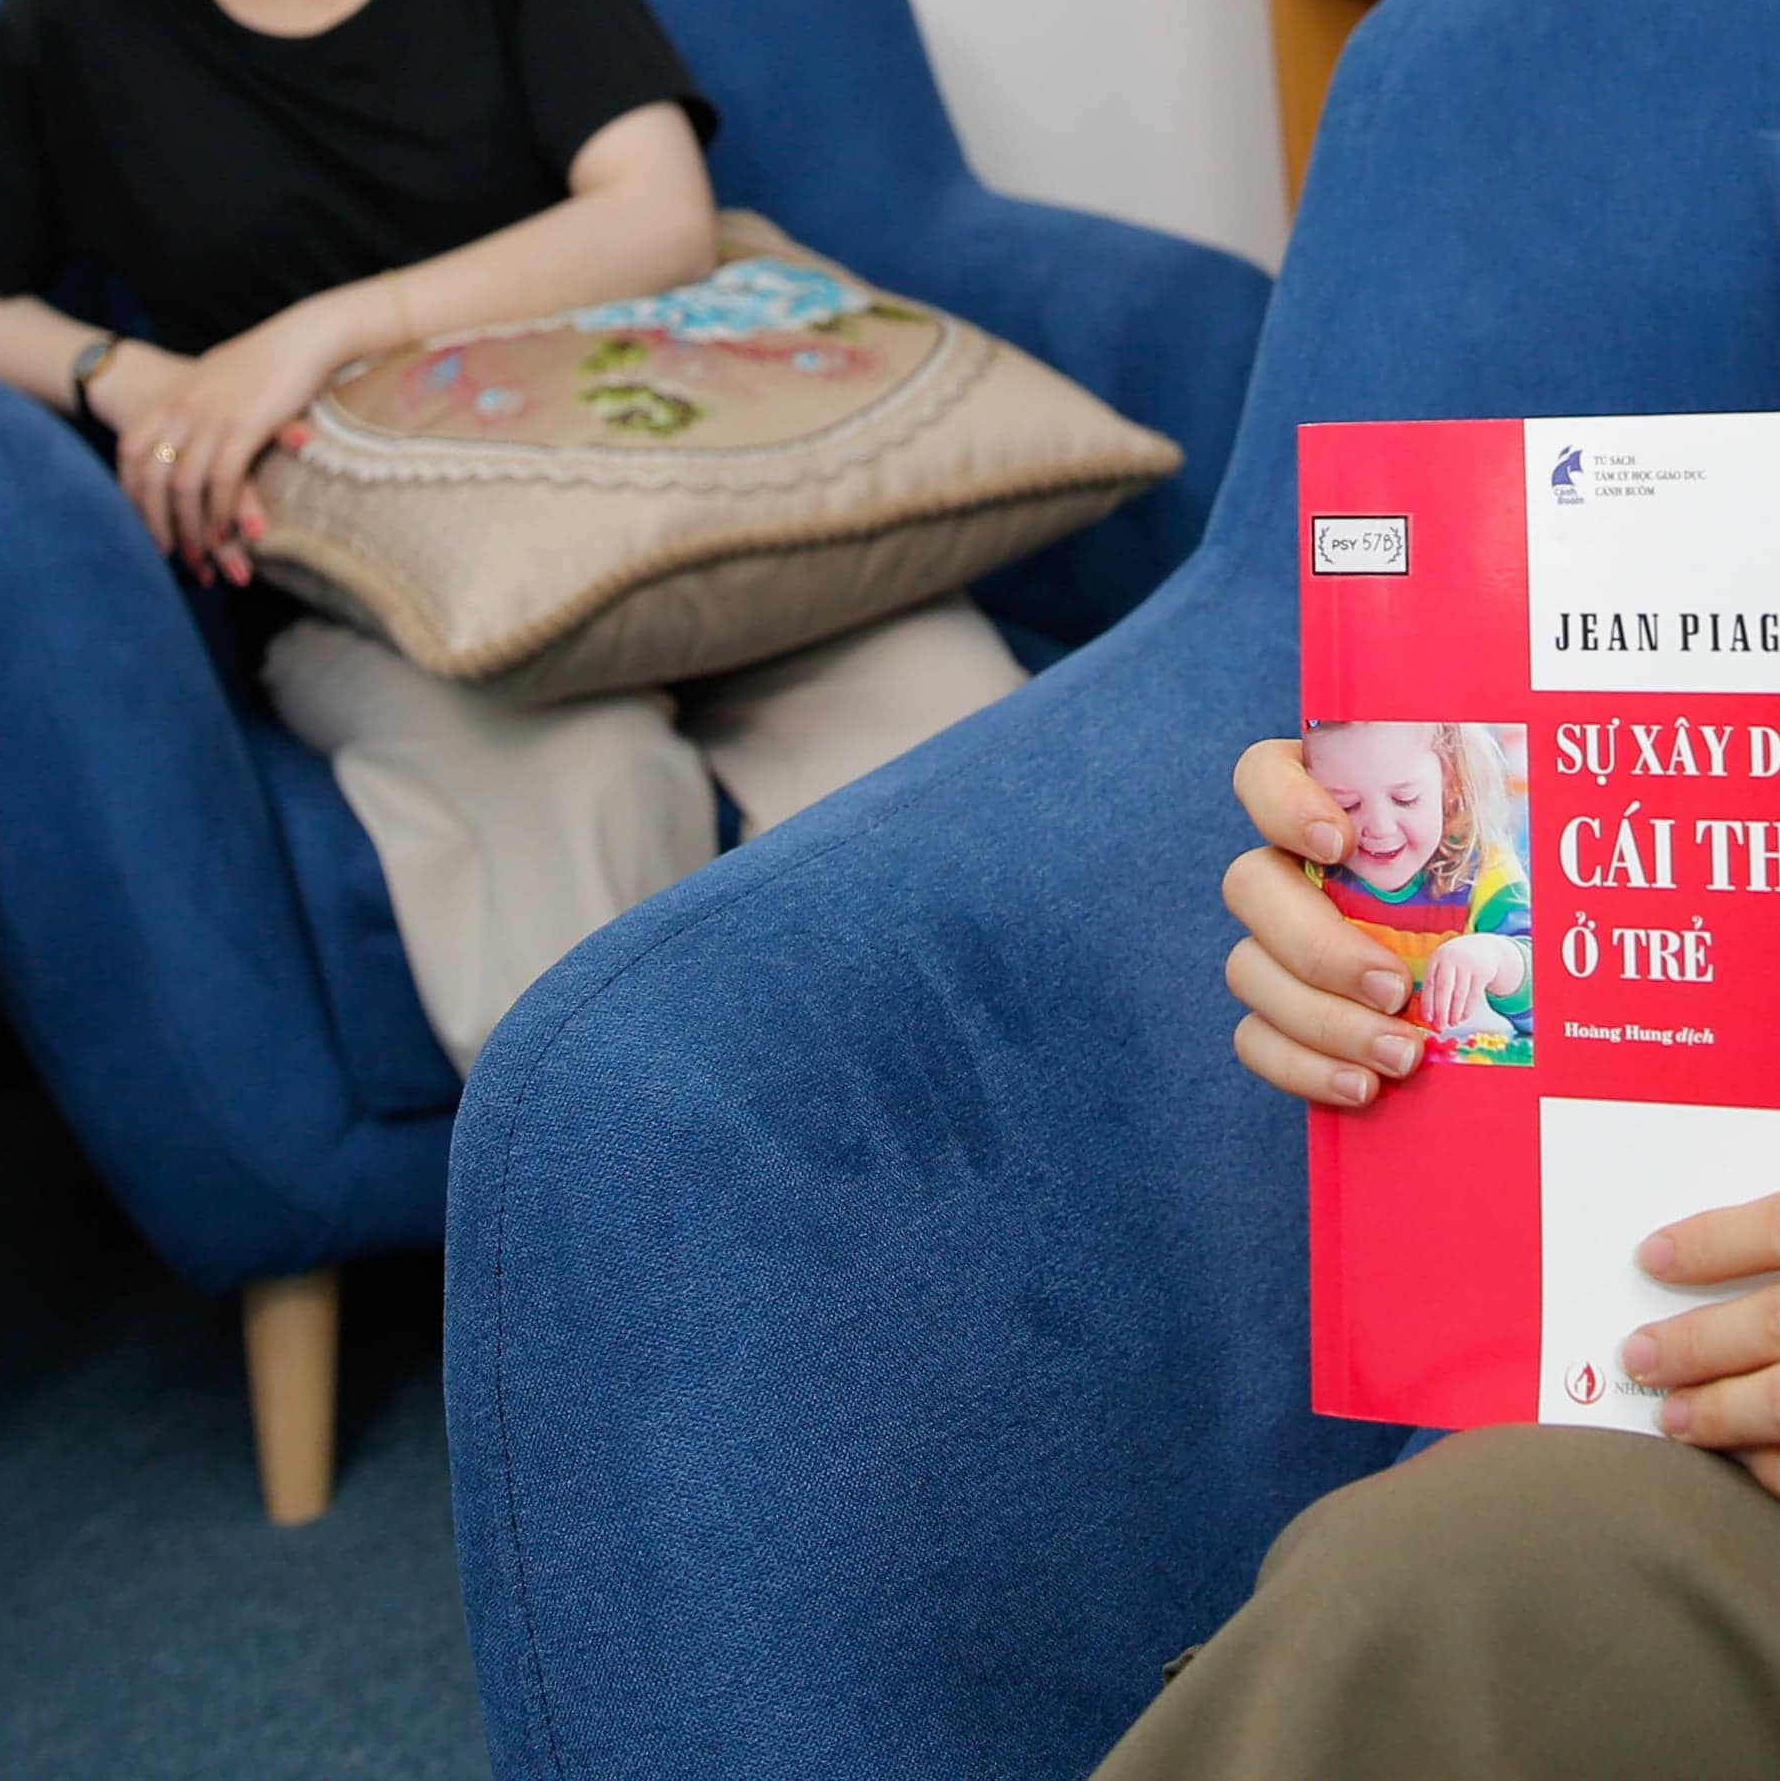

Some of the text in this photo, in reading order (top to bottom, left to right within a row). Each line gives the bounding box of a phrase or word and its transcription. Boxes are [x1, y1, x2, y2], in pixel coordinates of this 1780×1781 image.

[1331, 539, 1358, 552] PSY
[1555, 613, 1659, 652] JEAN
[1556, 716, 1621, 786] SỰ
[1630, 716, 1734, 777] XÂY
[1559, 801, 1677, 889] CÁI
[1562, 911, 1714, 983] Ở TRẺ
[1564, 1020, 1715, 1047] Hoàng Hung dịch
